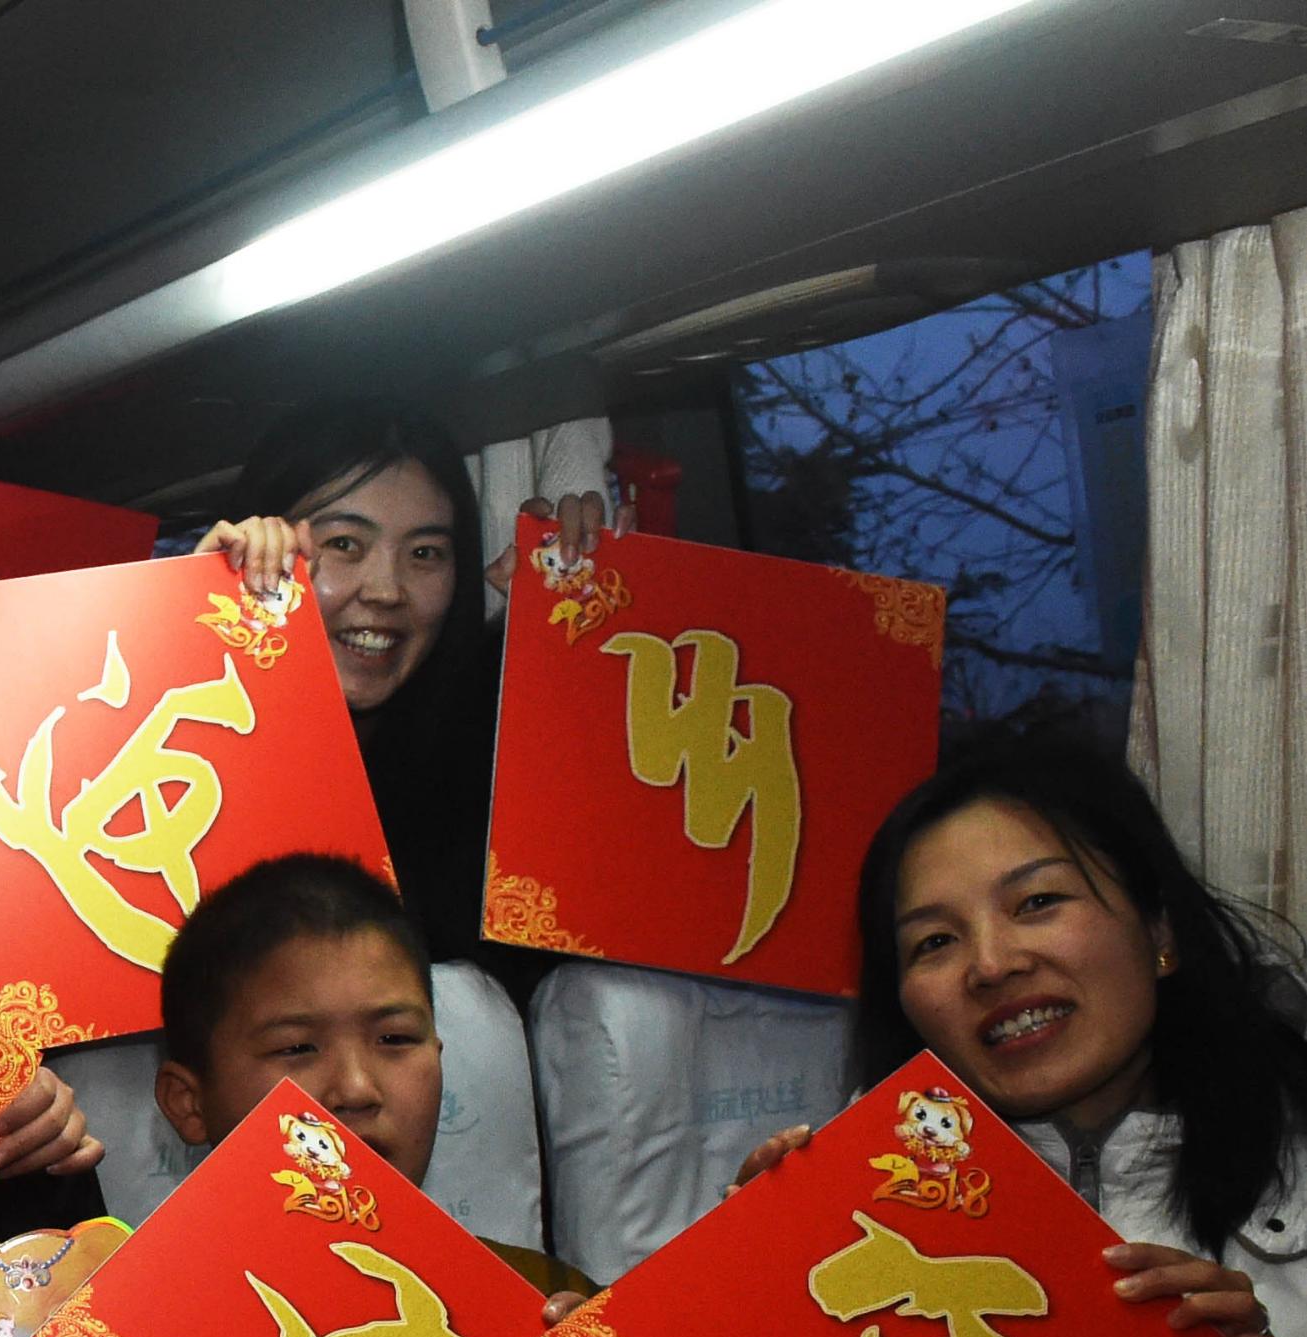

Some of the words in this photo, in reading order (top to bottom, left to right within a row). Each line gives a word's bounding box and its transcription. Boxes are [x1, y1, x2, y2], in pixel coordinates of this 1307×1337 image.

[194, 591, 289, 670] 2018
[548, 568, 633, 646] 2018
[270, 1169, 381, 1232] 2018
[868, 1153, 991, 1219] 2018
